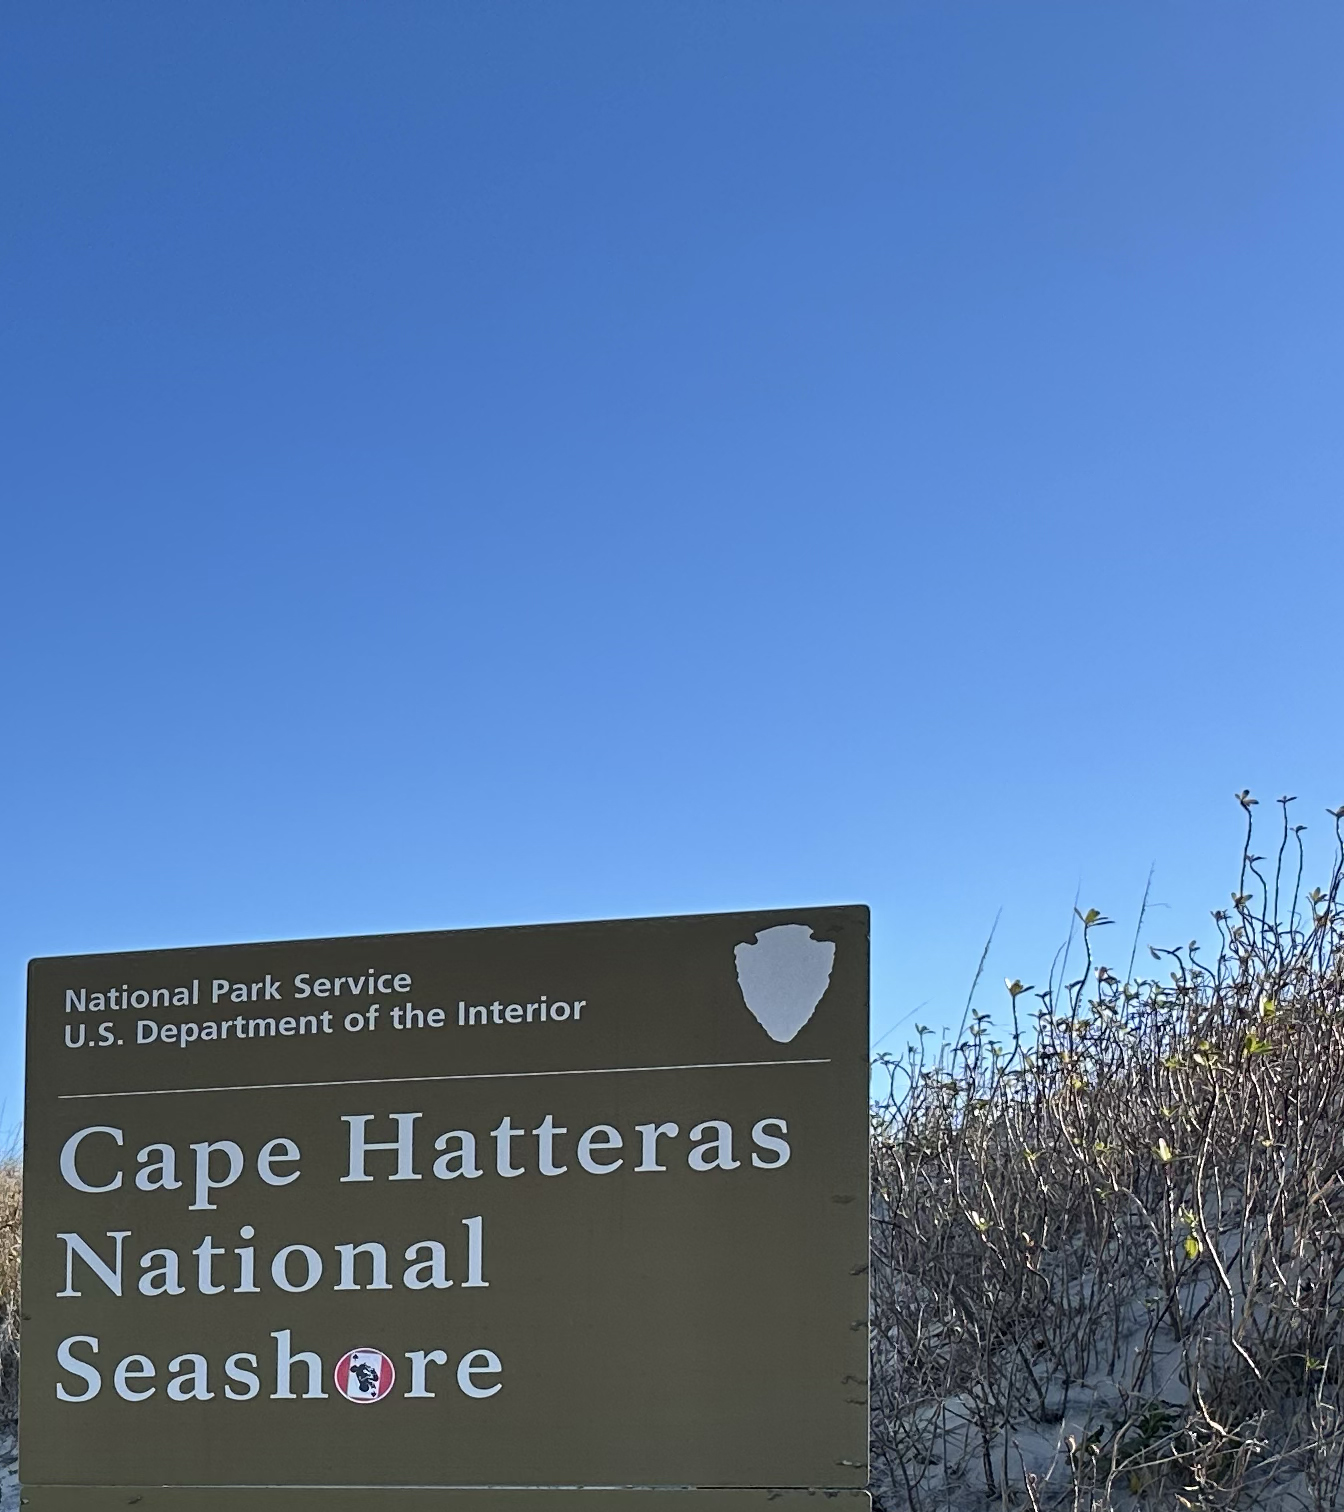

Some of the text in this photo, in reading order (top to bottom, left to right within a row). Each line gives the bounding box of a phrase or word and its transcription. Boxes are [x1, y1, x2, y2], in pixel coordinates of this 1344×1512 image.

[64, 995, 587, 1048] U.S. Department of the Interior
[65, 968, 412, 1012] National Park Service
[59, 1112, 791, 1210] Cape Hatteras
[56, 1215, 490, 1298] National
[56, 1329, 503, 1404] Seashre
